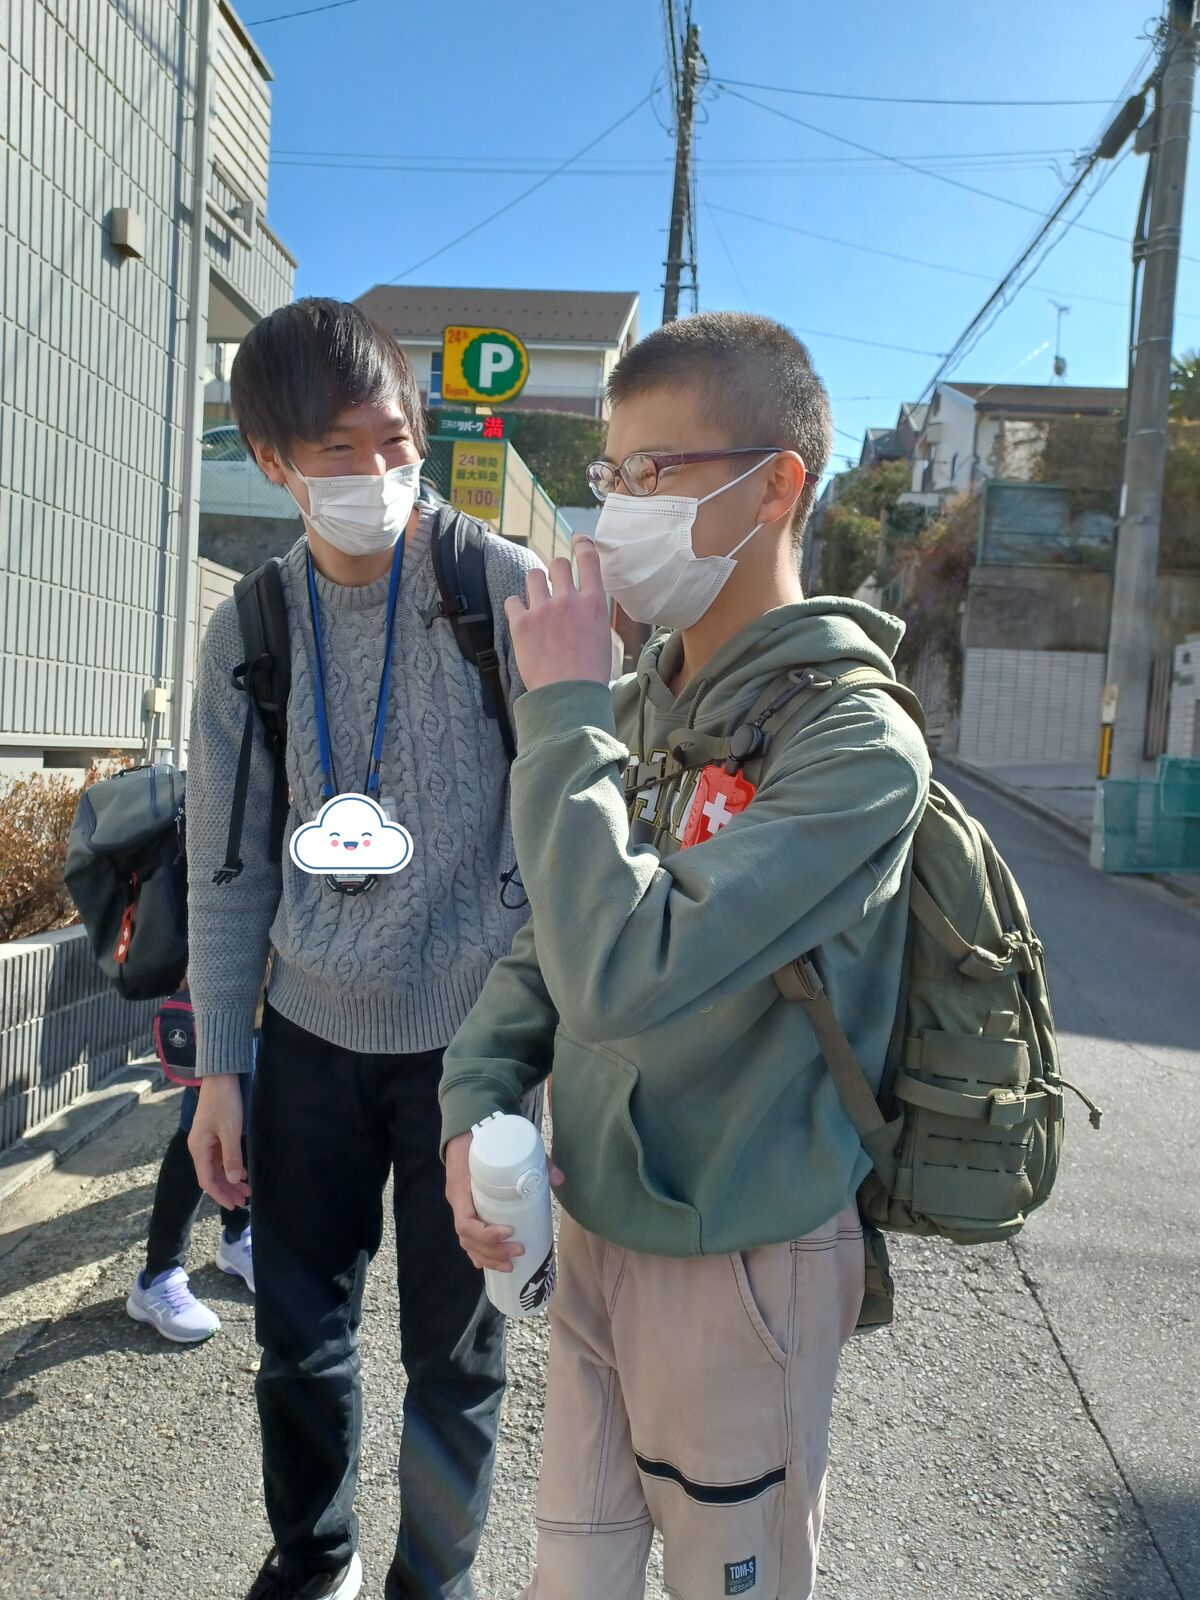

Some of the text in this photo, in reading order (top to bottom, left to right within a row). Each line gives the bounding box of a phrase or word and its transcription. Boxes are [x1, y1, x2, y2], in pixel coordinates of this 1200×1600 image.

[479, 342, 515, 389] P
[483, 416, 504, 439] 満
[458, 454, 498, 468] 24時間
[456, 468, 498, 482] 最大料金
